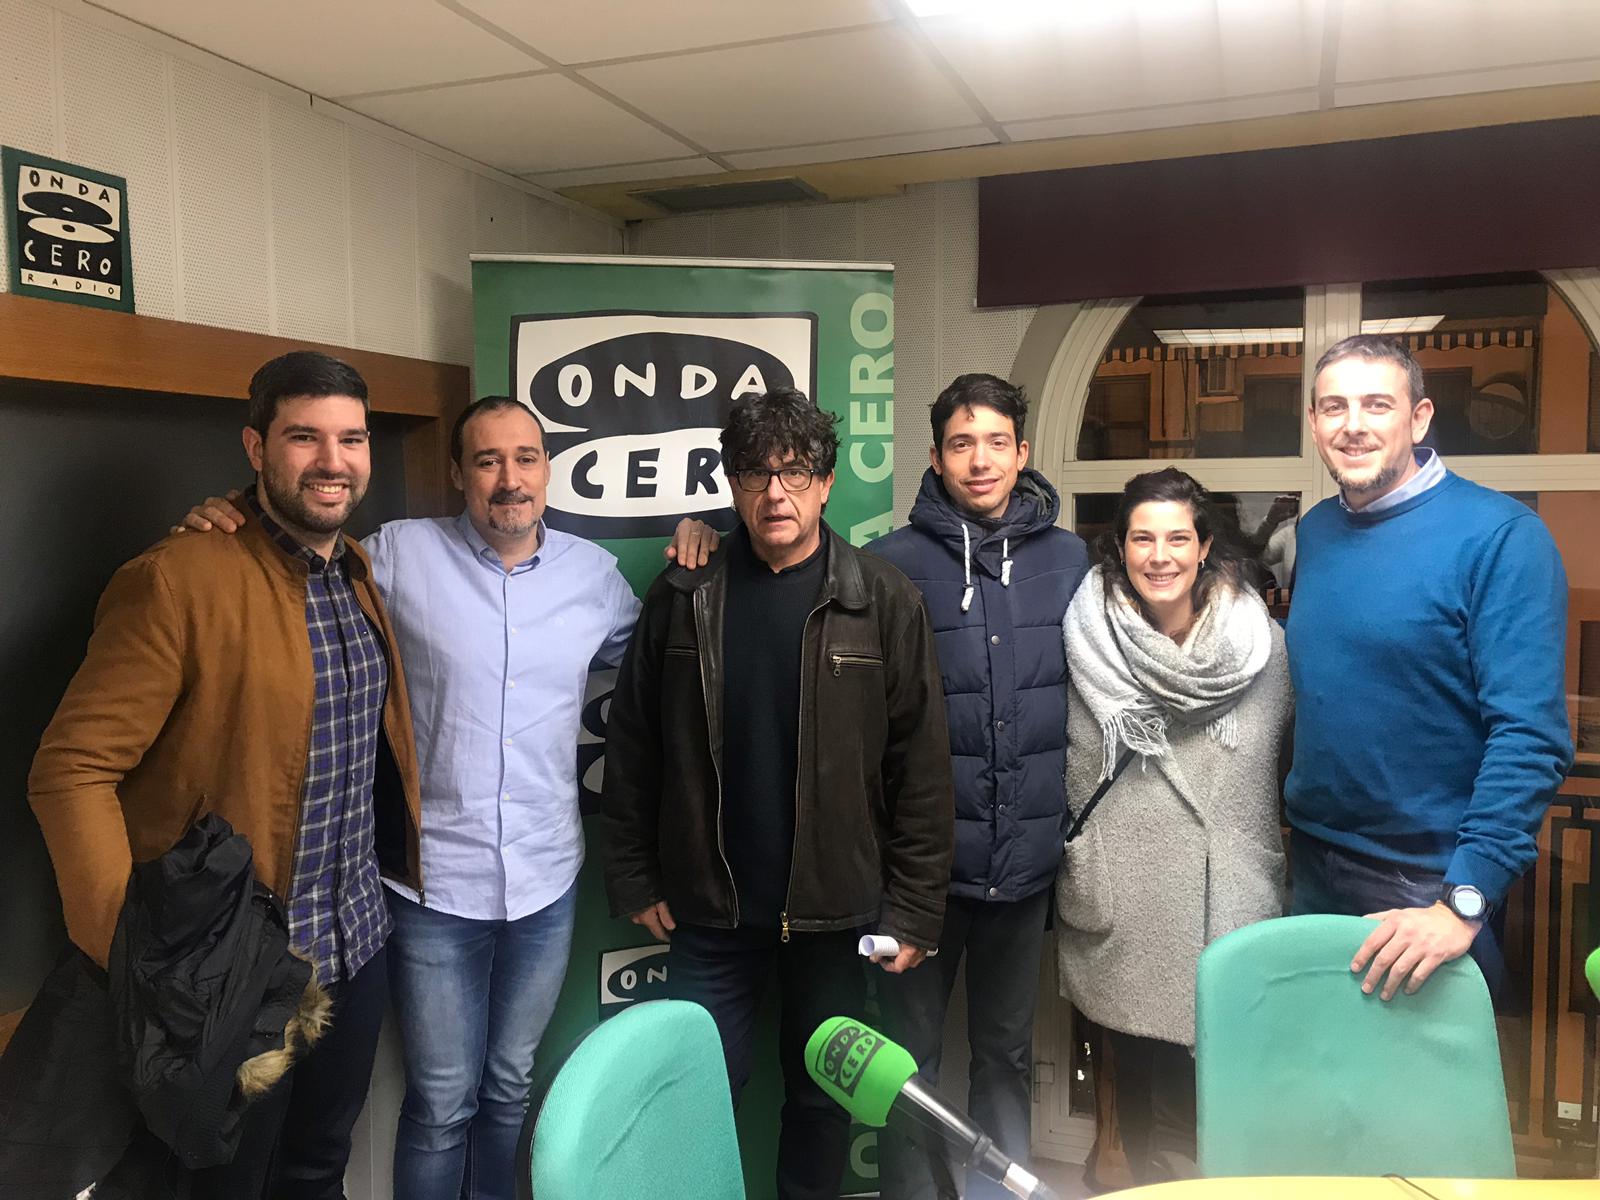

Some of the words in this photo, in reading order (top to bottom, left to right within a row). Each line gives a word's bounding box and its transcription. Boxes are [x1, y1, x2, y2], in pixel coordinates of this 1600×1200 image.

[29, 170, 110, 203] ONDA
[24, 239, 112, 276] CERO
[27, 274, 115, 295] RADIO
[558, 362, 768, 407] ONDA
[849, 292, 894, 483] CERO
[571, 447, 722, 499] CER
[620, 965, 668, 990] ON
[826, 1028, 858, 1070] ONDA
[841, 1037, 873, 1079] CERO
